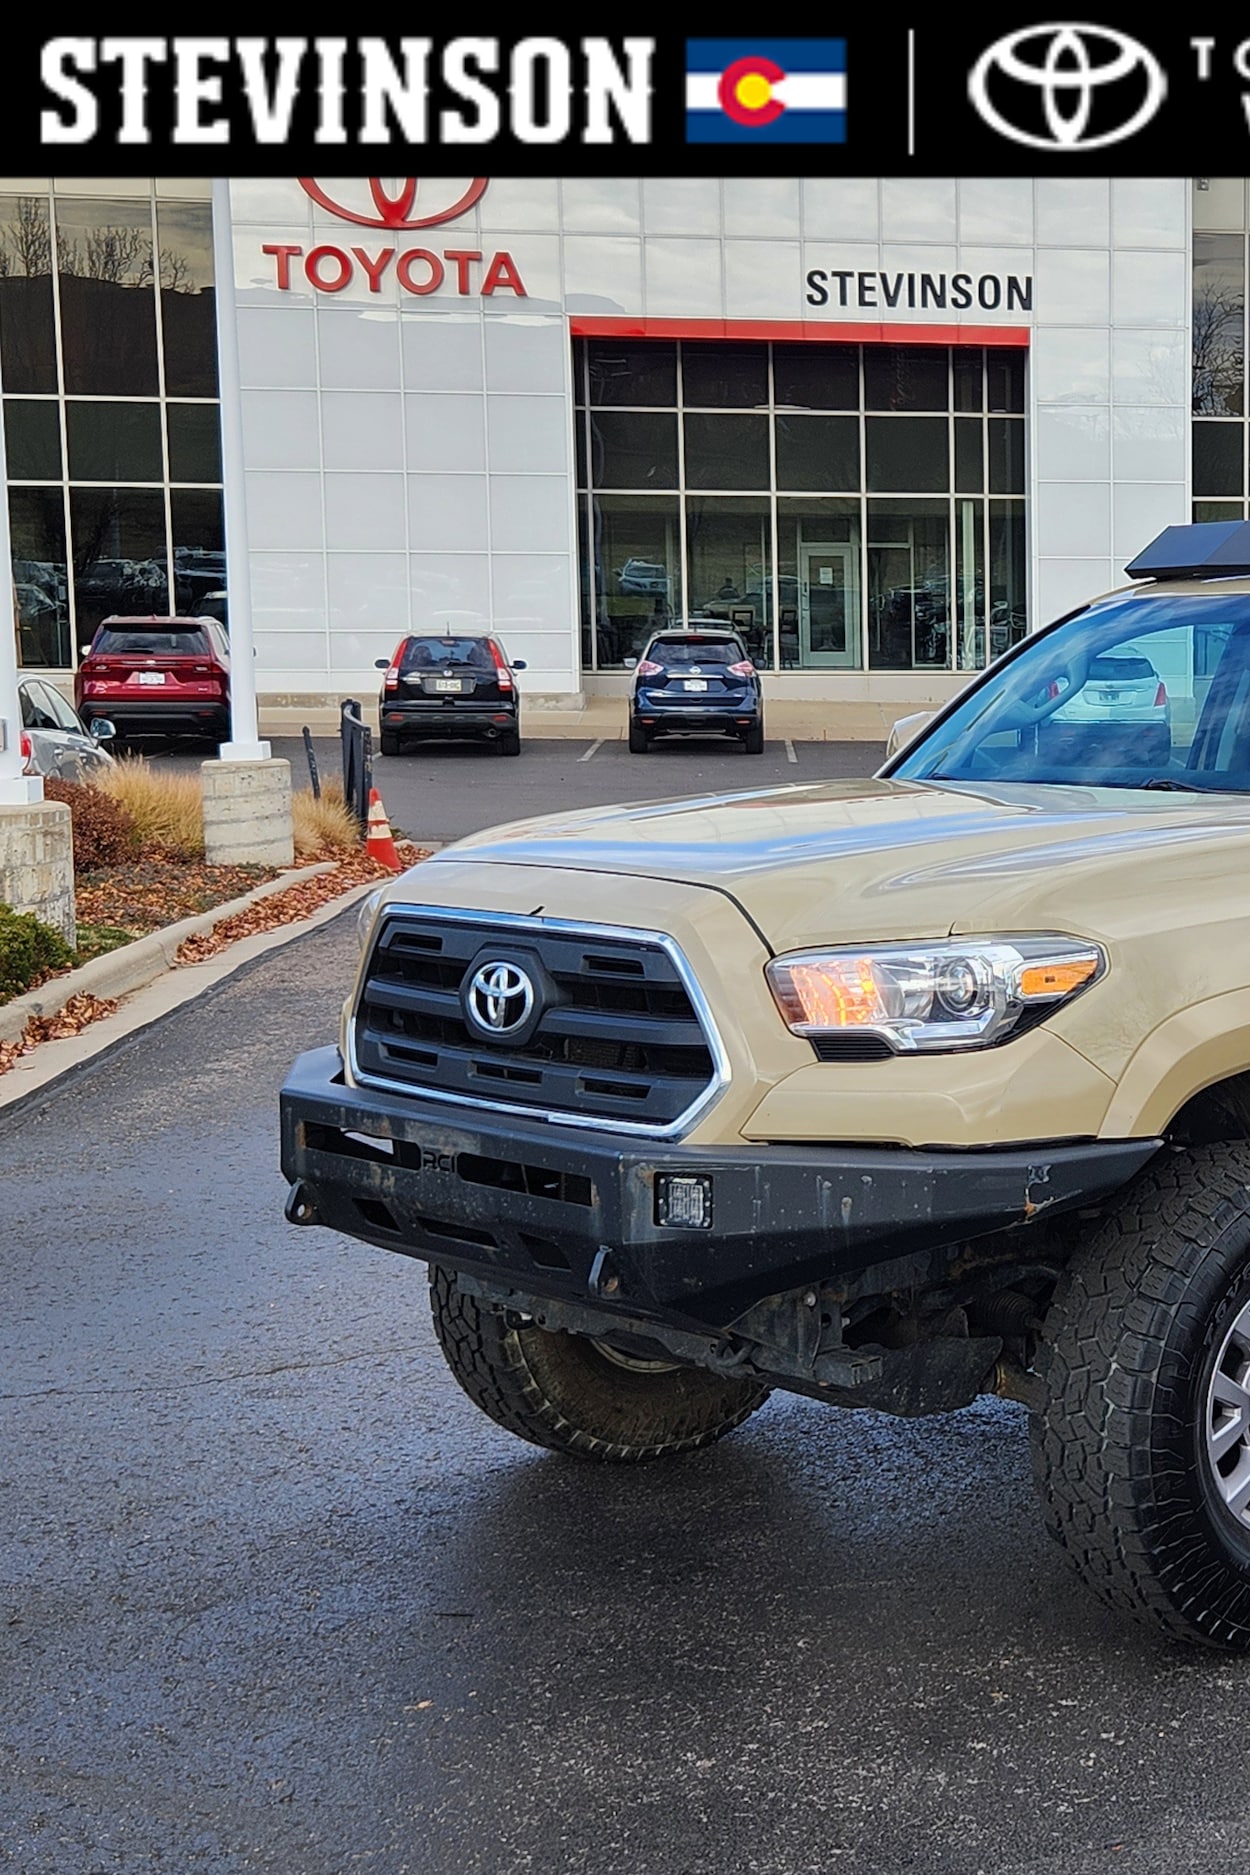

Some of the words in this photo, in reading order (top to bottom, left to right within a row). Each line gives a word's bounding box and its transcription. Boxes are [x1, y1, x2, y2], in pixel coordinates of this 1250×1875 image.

[262, 244, 526, 297] TOYOTA
[805, 269, 1034, 311] STEVINSON
[423, 1150, 456, 1173] RCI
